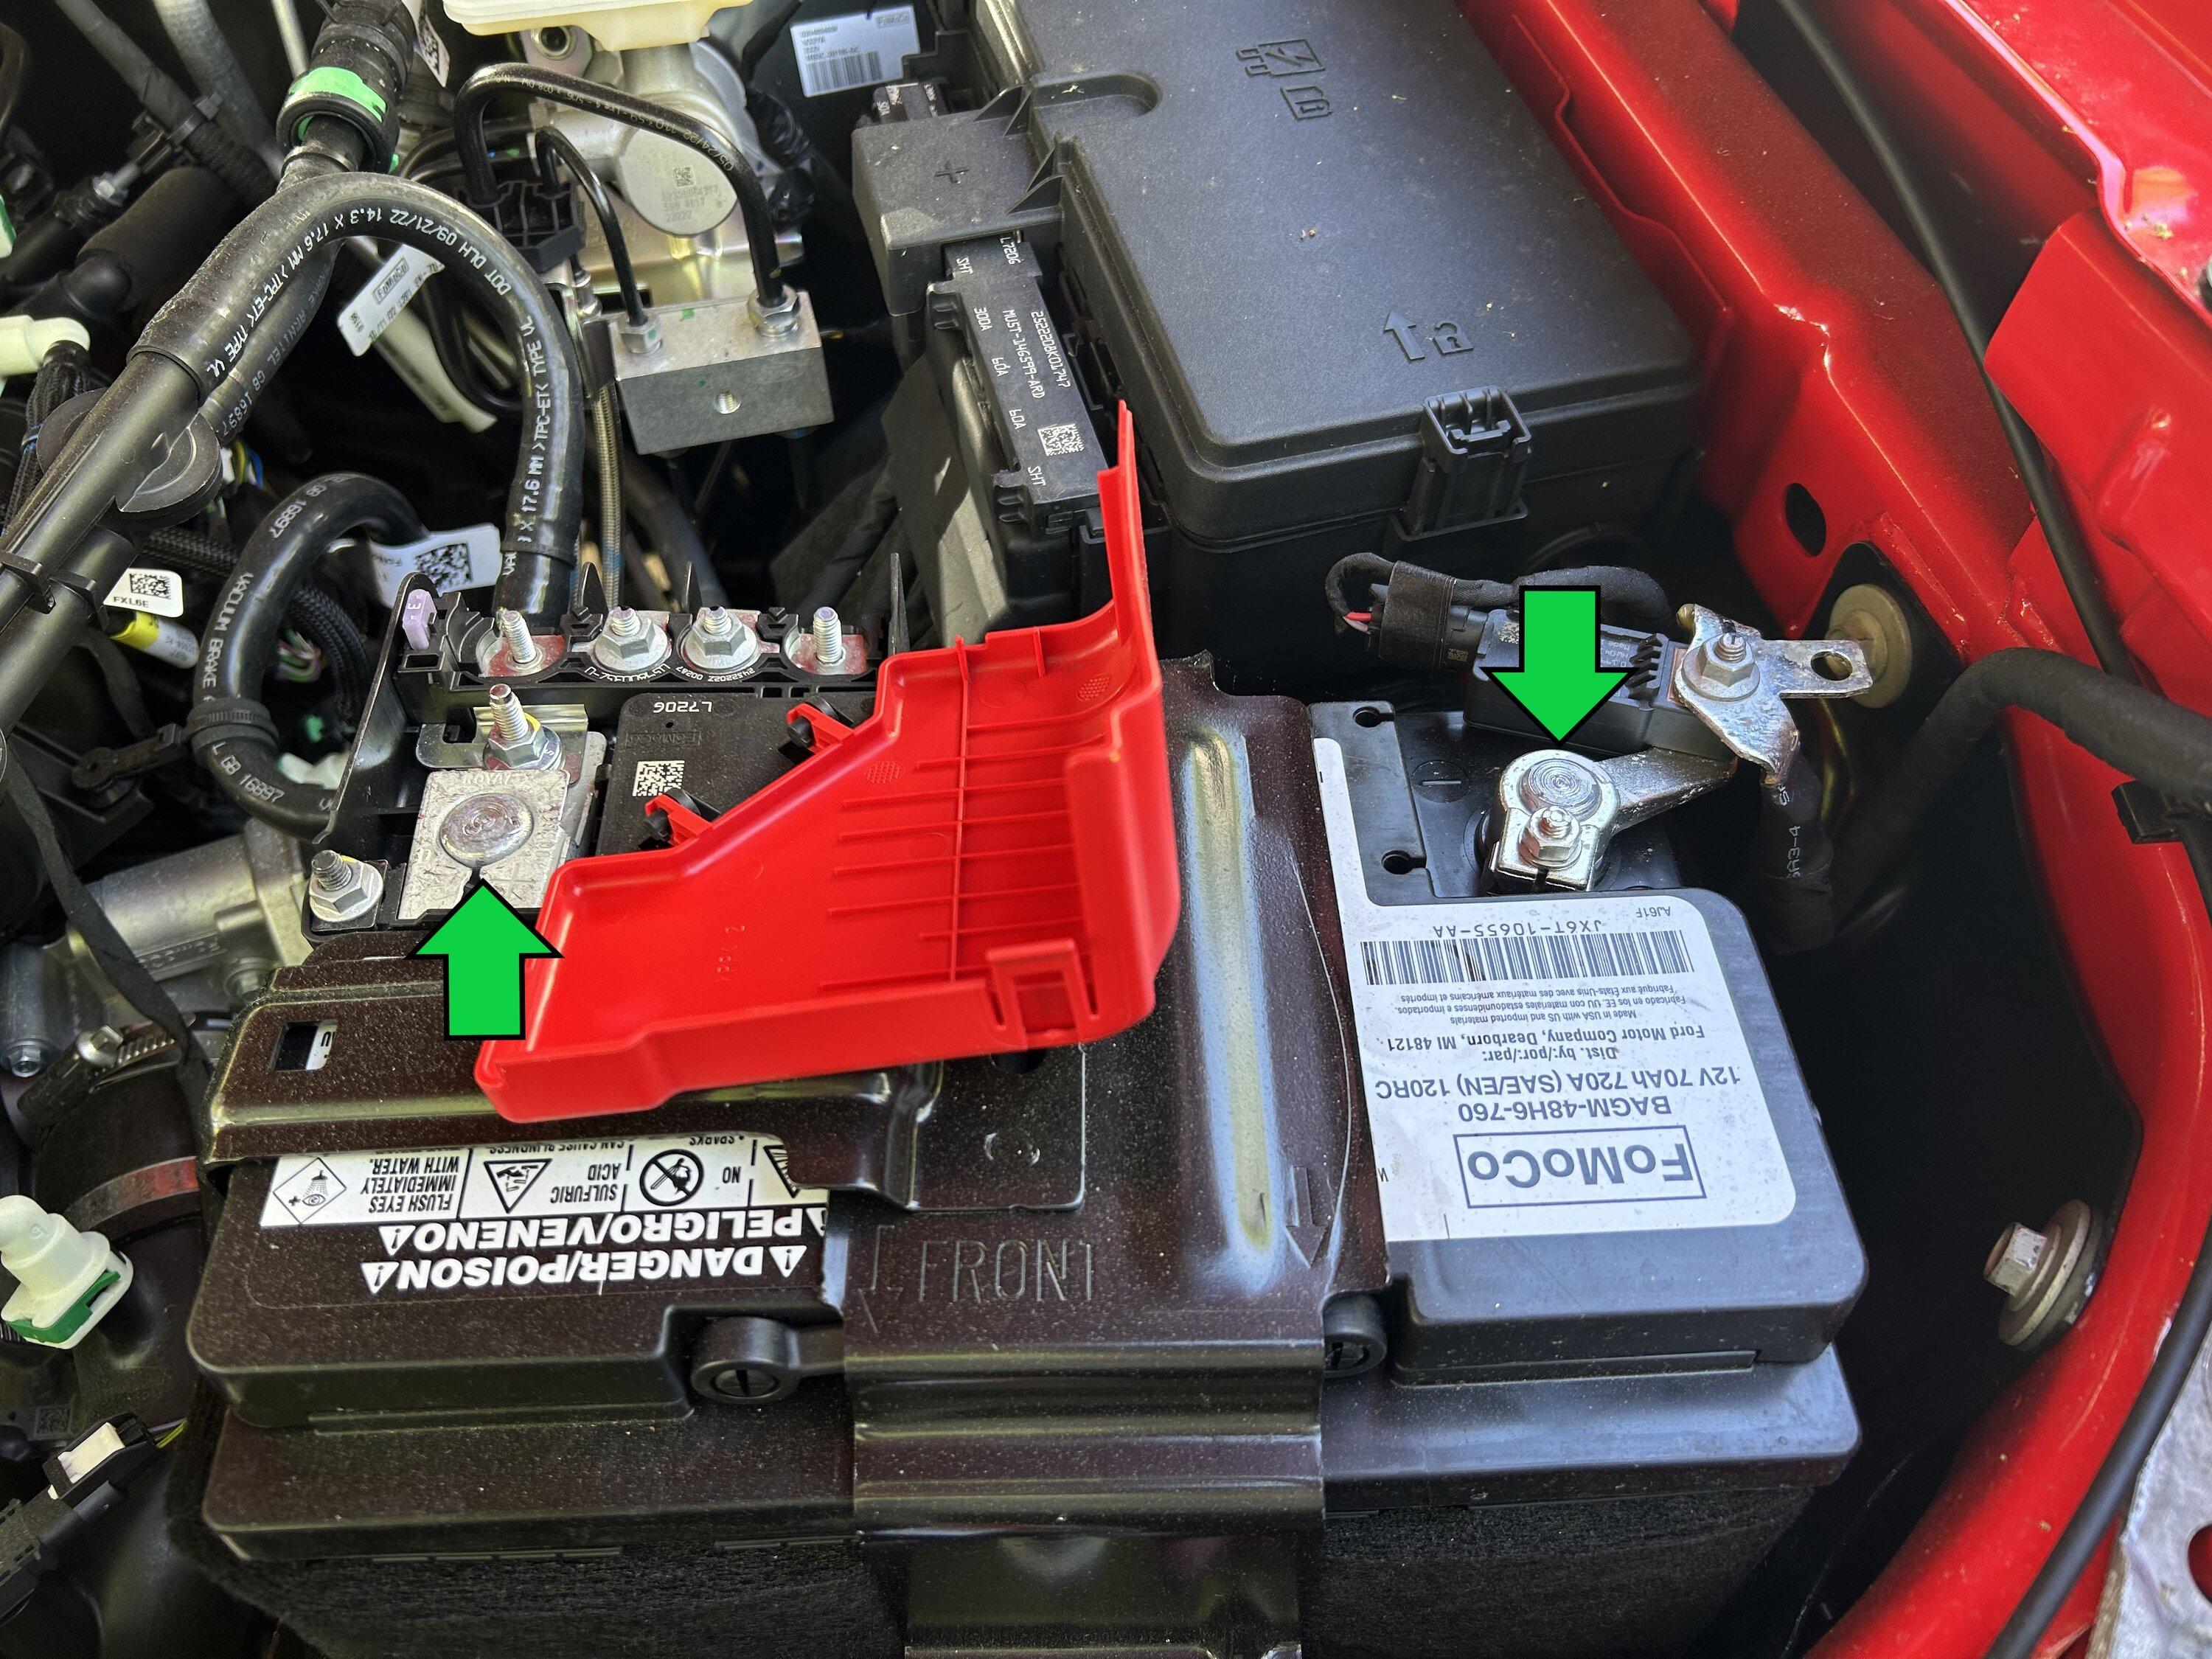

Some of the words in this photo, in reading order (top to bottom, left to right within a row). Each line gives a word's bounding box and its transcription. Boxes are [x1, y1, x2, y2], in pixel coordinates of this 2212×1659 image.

[349, 207, 383, 225] 14.3
[389, 209, 459, 246] 09/21/22
[304, 223, 330, 252] 17.6
[288, 245, 304, 271] MM
[956, 257, 974, 276] SHT
[484, 269, 512, 296] DOT
[224, 324, 248, 363] TYPE
[526, 339, 547, 378] TYPE
[973, 306, 993, 332] 300A
[1008, 408, 1027, 431] 60A
[251, 369, 267, 392] GB
[223, 391, 254, 437] 16897
[527, 456, 544, 476] MM
[1028, 465, 1047, 487] SHT
[521, 479, 542, 514] 17.6
[201, 637, 224, 689] BRAKE
[221, 754, 242, 775] GB
[1635, 905, 1672, 919] AJ61F
[1432, 919, 1602, 938] JX6T-10655-AA
[1400, 992, 1439, 1005] importés
[1439, 994, 1448, 1002] et
[1449, 991, 1495, 1002] américains
[1495, 990, 1537, 1000] matériaux
[1539, 990, 1554, 998] des
[1556, 989, 1576, 997] avec
[1576, 987, 1619, 998] États-Unis
[1621, 987, 1637, 995] aux
[1638, 984, 1674, 996] Fabriqué
[1454, 1002, 1523, 1013] estadounidenses
[1526, 1001, 1568, 1009] materiales
[1587, 1000, 1601, 1008] UU
[1618, 998, 1632, 1006] los
[1645, 995, 1687, 1005] Fabricado
[1450, 1016, 1488, 1026] materials
[1491, 1012, 1528, 1023] imported
[1530, 1013, 1545, 1022] and
[1548, 1013, 1560, 1022] US
[1562, 1012, 1581, 1021] with
[1582, 1012, 1601, 1020] USA
[1603, 1011, 1612, 1019] in
[1613, 1010, 1637, 1019] Made
[1461, 1032, 1538, 1047] Dearborn,
[1542, 1028, 1617, 1043] Company,
[1621, 1028, 1666, 1041] Motor
[1669, 1026, 1705, 1040] Ford
[1388, 1037, 1432, 1051] 48121
[1437, 1036, 1456, 1049] MI
[1580, 1047, 1620, 1060] Dist.
[1565, 1070, 1628, 1091] 720A
[1631, 1068, 1693, 1089] 70Ah
[1699, 1065, 1741, 1086] 12V
[1374, 1077, 1451, 1101] 120RC
[1456, 1071, 1563, 1099] (SAE/EN)
[1458, 1095, 1672, 1123] BAGM-48H6-760
[369, 1158, 420, 1176] WATER.
[425, 1155, 460, 1174] WITH
[588, 1162, 622, 1181] ACID
[1467, 1142, 1694, 1189] FoMoCo
[722, 1166, 742, 1184] NO
[360, 1175, 456, 1194] IMMEDIATELY
[549, 1183, 618, 1204] SULFURIC
[369, 1195, 403, 1214] EYES
[408, 1193, 451, 1212] FLUSH
[413, 1207, 804, 1253] PELIGRO/VENENO
[394, 1245, 765, 1291] DANGER/POISON
[919, 1238, 1093, 1304] FRONT
